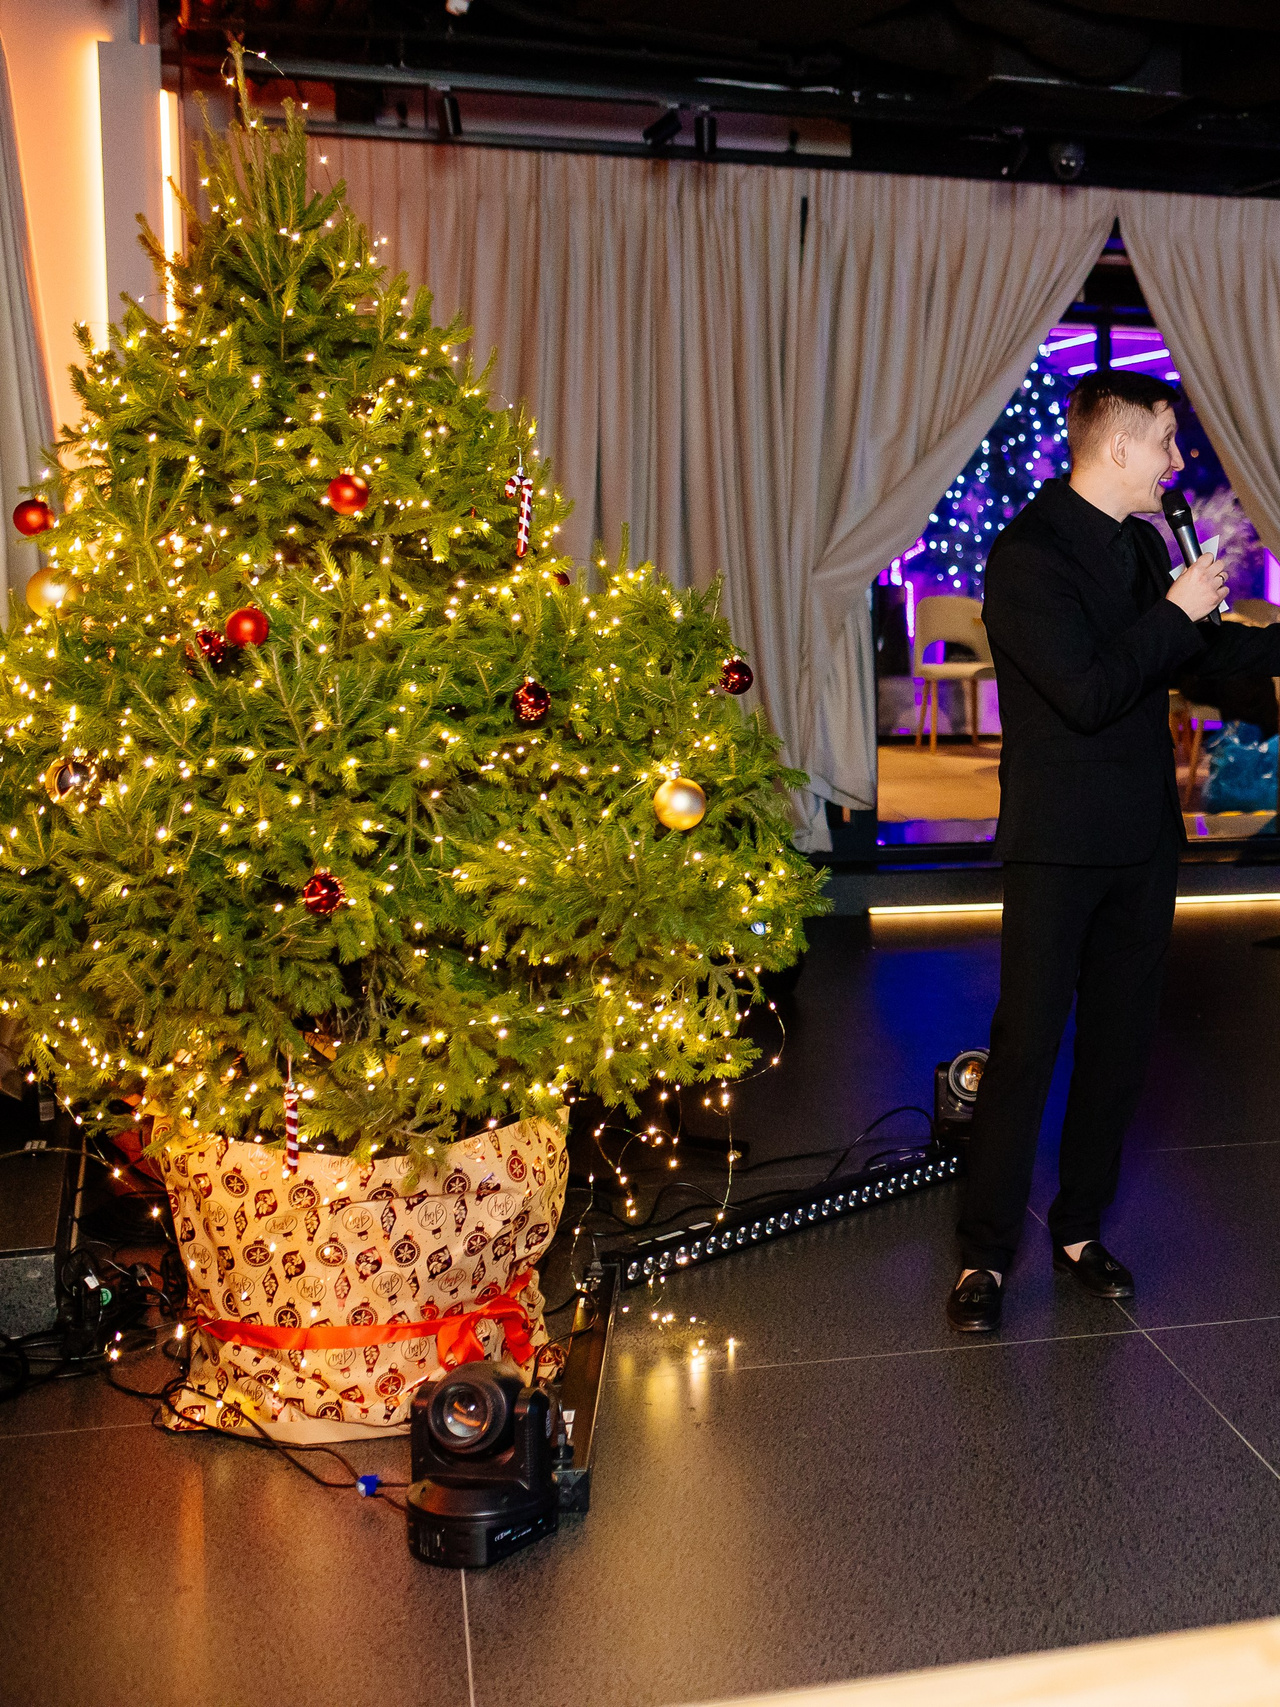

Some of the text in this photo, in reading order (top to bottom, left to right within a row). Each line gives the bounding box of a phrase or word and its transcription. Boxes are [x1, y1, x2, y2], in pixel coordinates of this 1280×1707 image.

[491, 1193, 513, 1213] Joy
[423, 1203, 444, 1223] Joy
[271, 1218, 293, 1230] Joy
[378, 1273, 400, 1293] Joy
[442, 1269, 464, 1285] Joy
[301, 1279, 323, 1298] Joy
[406, 1338, 427, 1356] Joy
